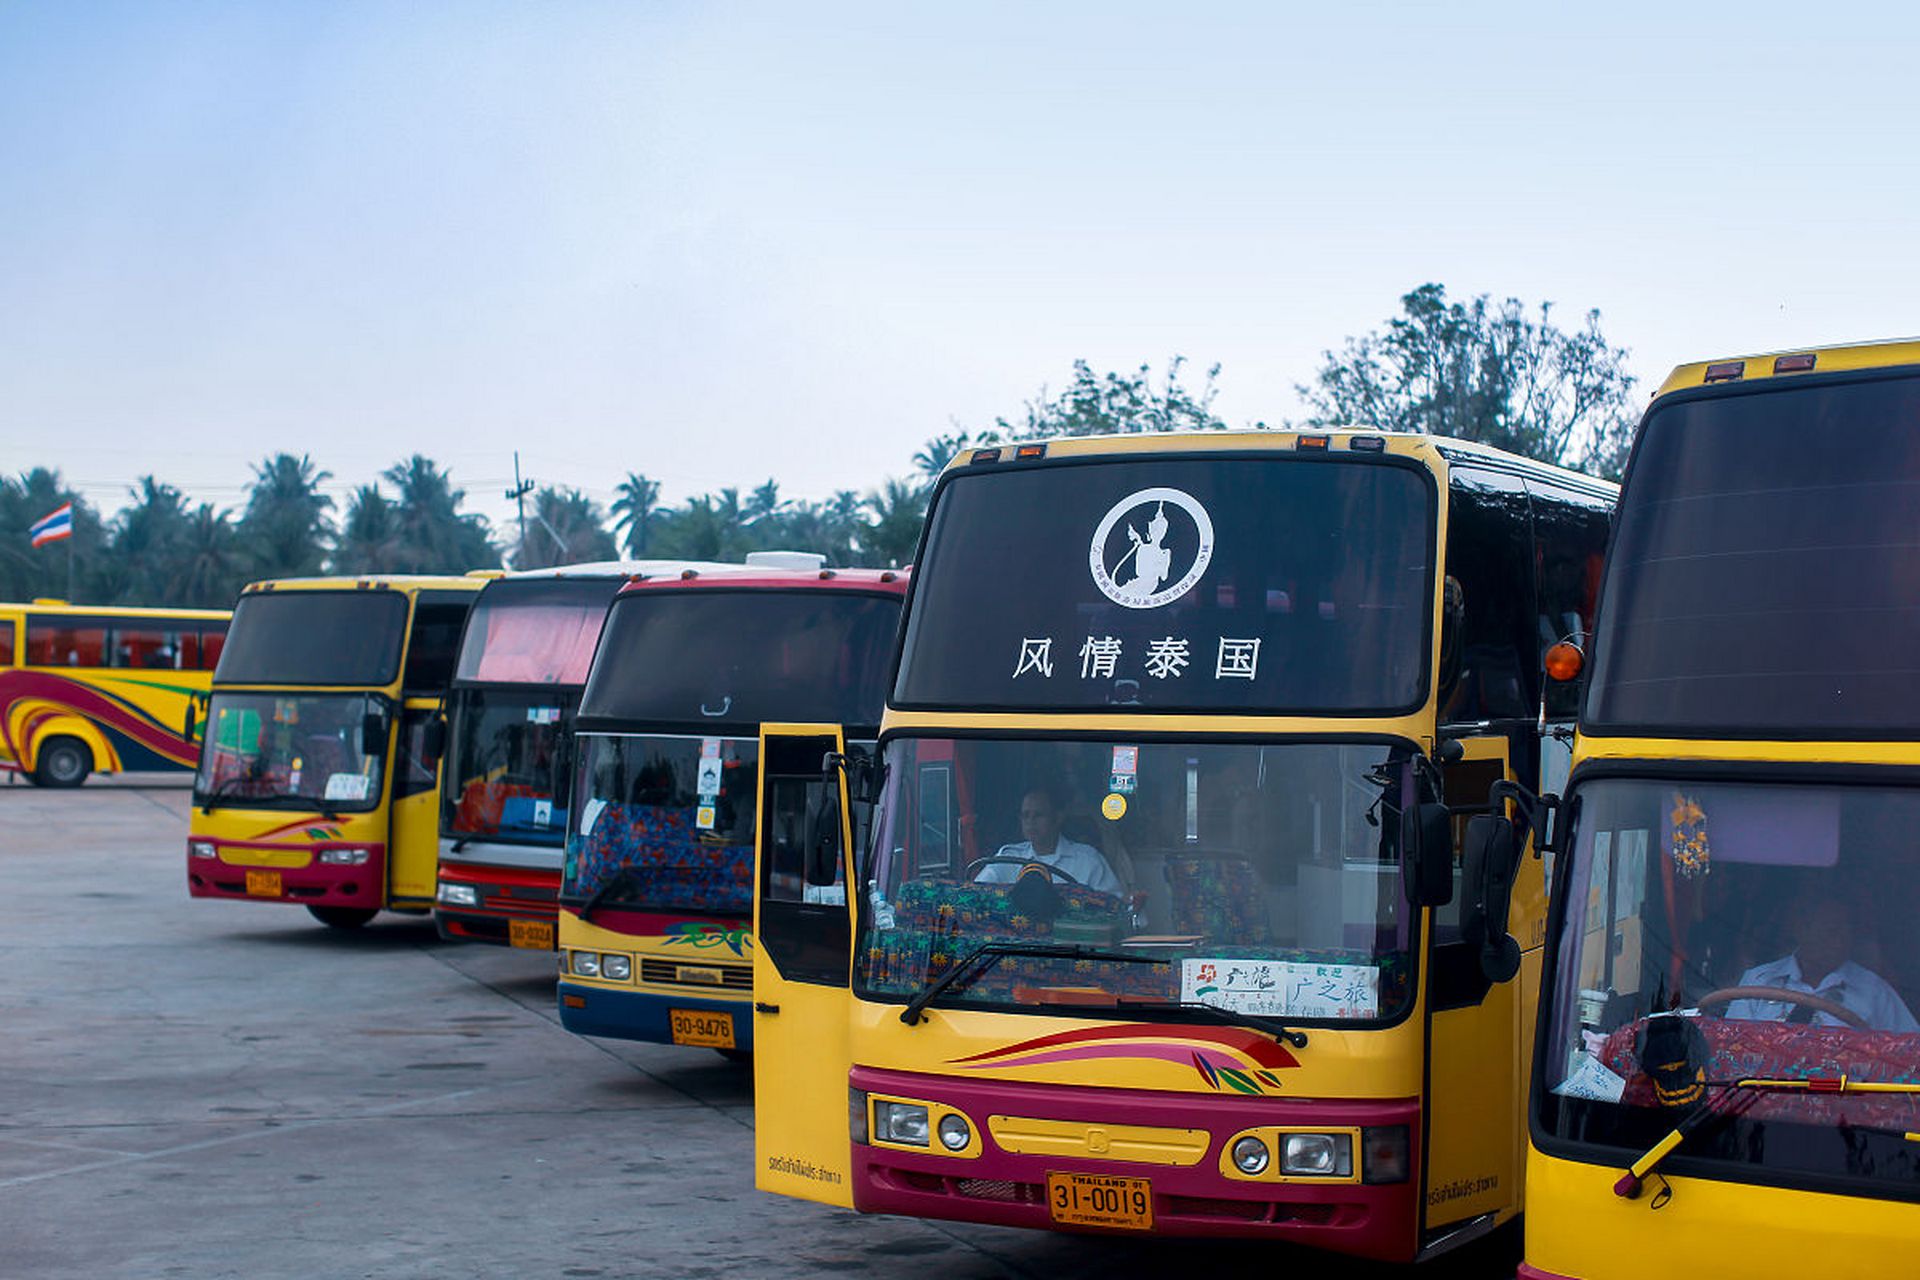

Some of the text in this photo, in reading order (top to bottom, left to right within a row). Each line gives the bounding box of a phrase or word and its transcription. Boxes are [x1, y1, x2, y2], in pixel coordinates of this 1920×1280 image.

[1012, 635, 1262, 681] 风情泰国
[675, 1016, 729, 1038] 30-9476
[1072, 1177, 1126, 1187] THAILAND
[1055, 1185, 1146, 1215] 31-0019
